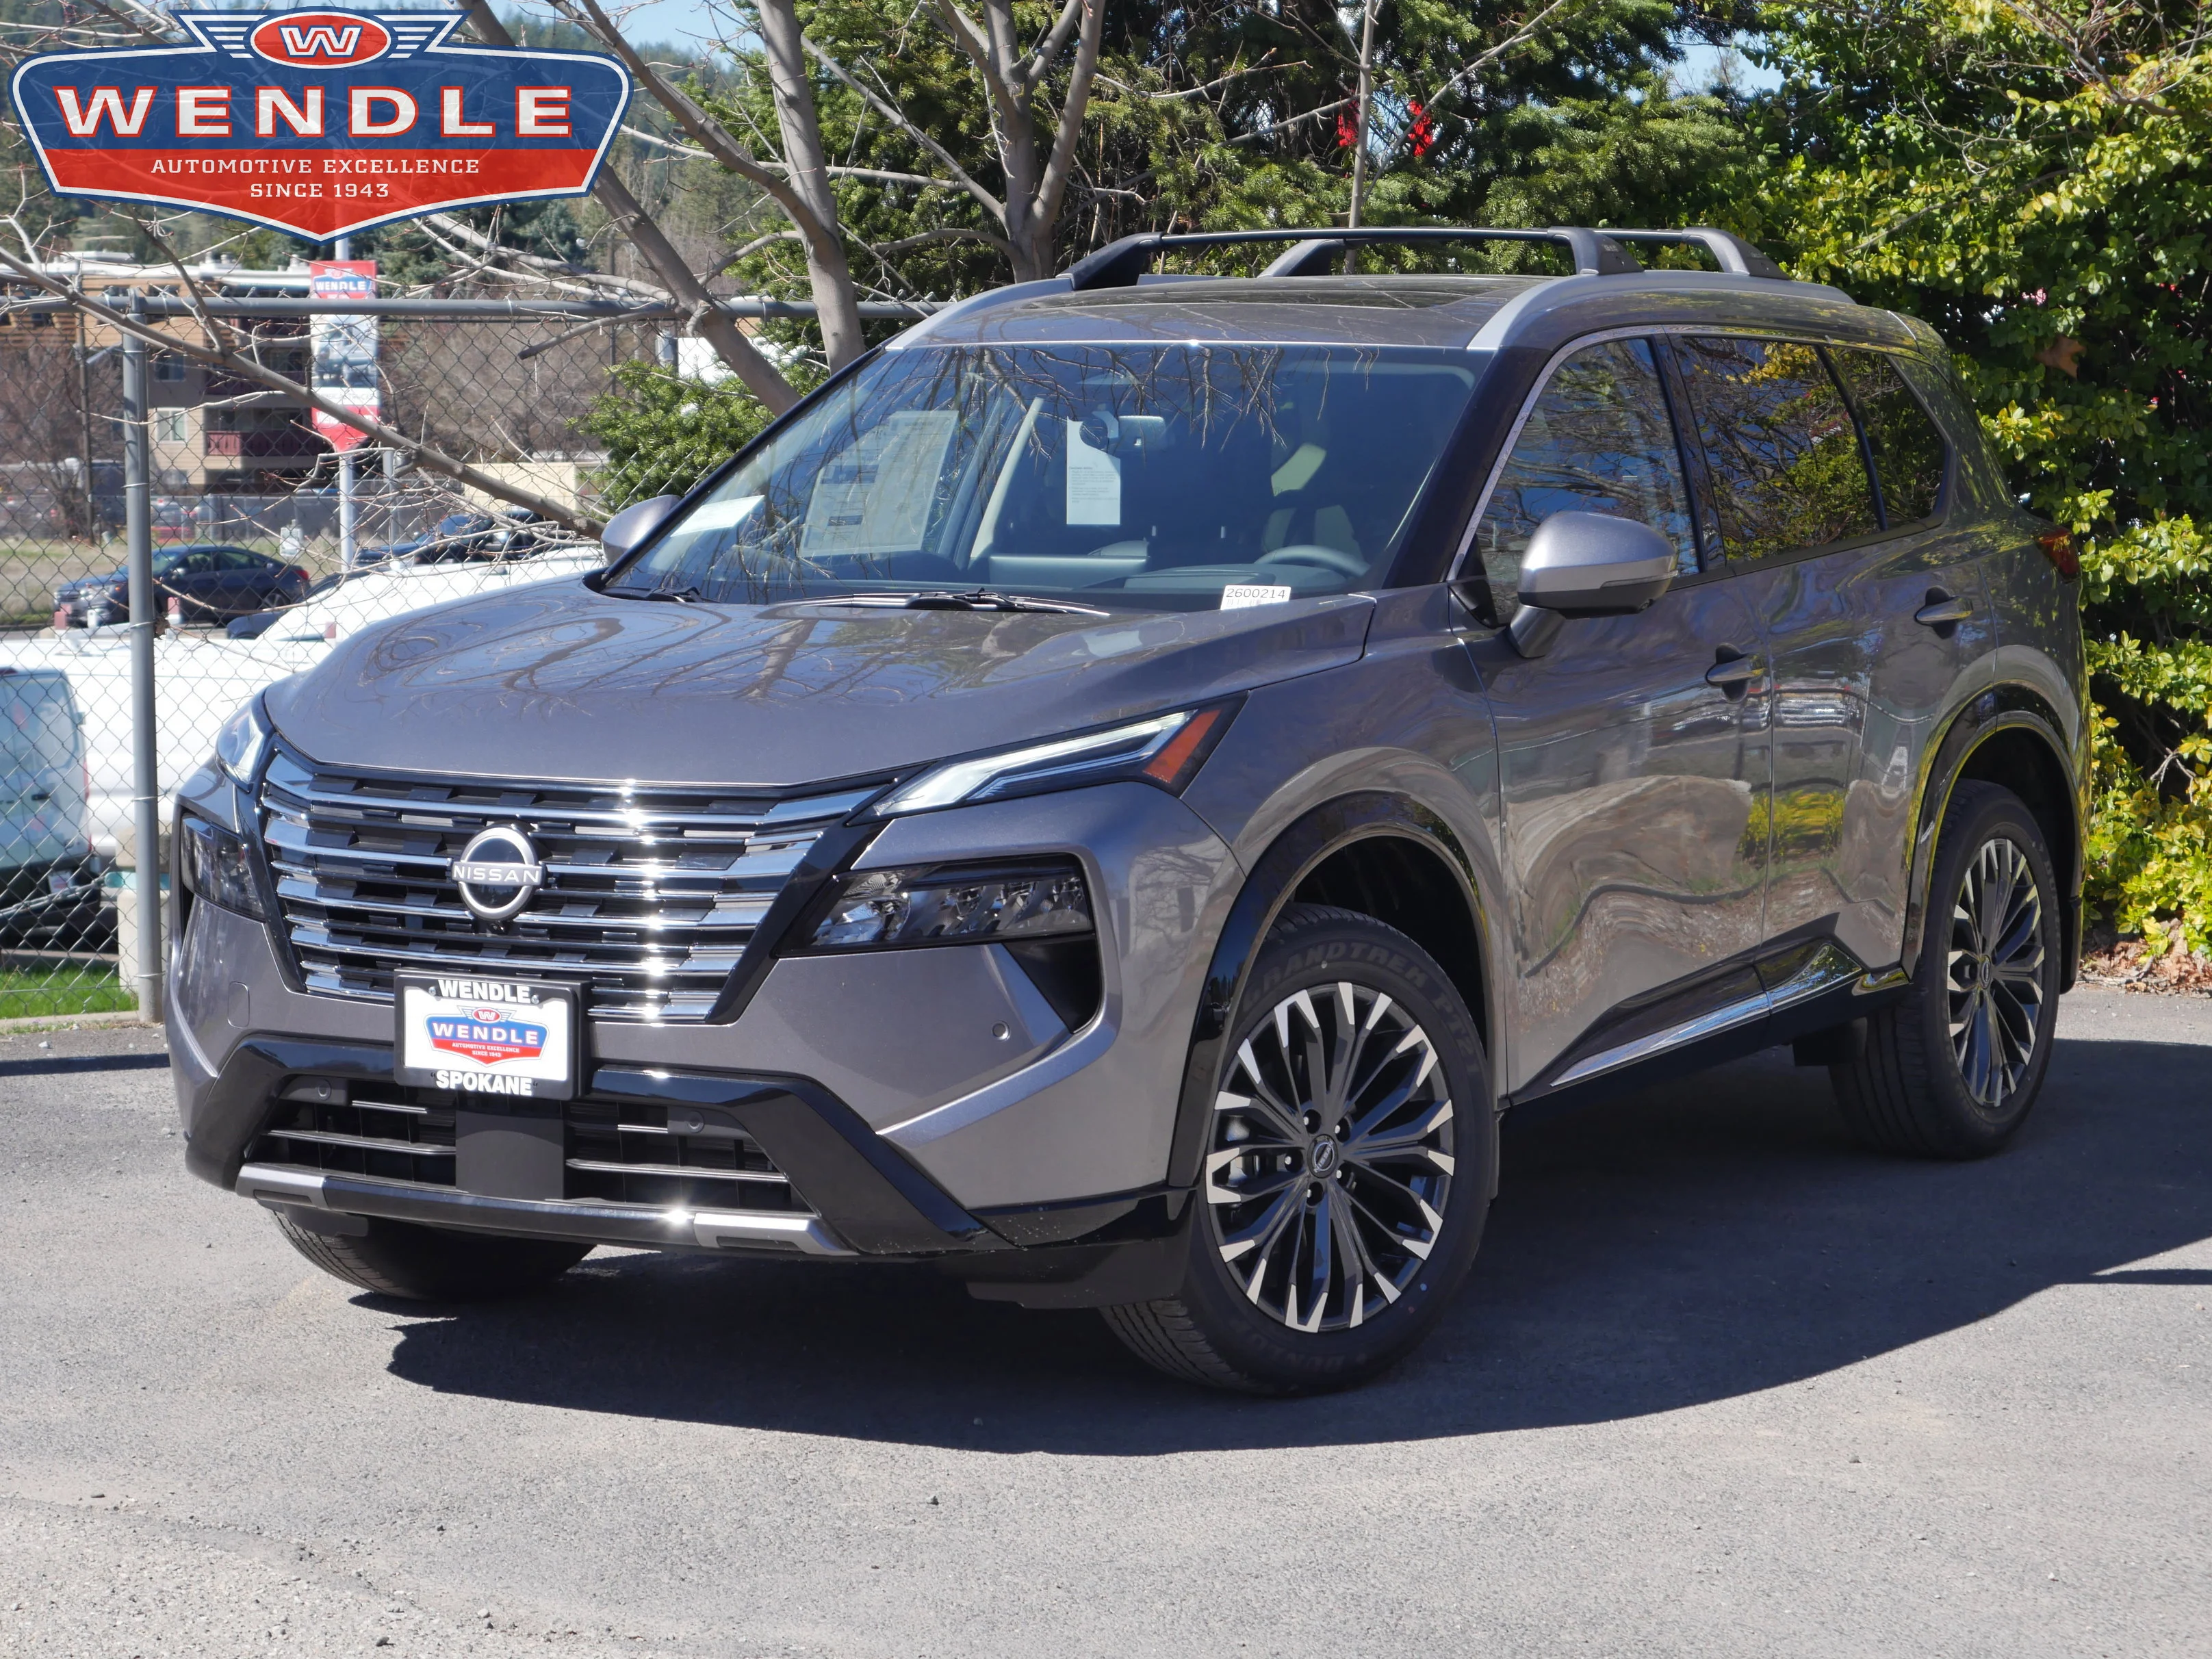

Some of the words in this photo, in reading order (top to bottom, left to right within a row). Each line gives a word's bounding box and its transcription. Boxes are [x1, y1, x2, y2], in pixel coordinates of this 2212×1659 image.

[315, 281, 366, 291] WENDLE
[1226, 588, 1285, 599] 2600214
[453, 864, 539, 883] NISSAN
[1242, 941, 1428, 1013] GRANDTREK
[437, 979, 531, 1004] WENDLE
[432, 1022, 538, 1045] WENDLE
[487, 1045, 520, 1053] EXCELLENCE
[435, 1069, 532, 1096] SPOKANE
